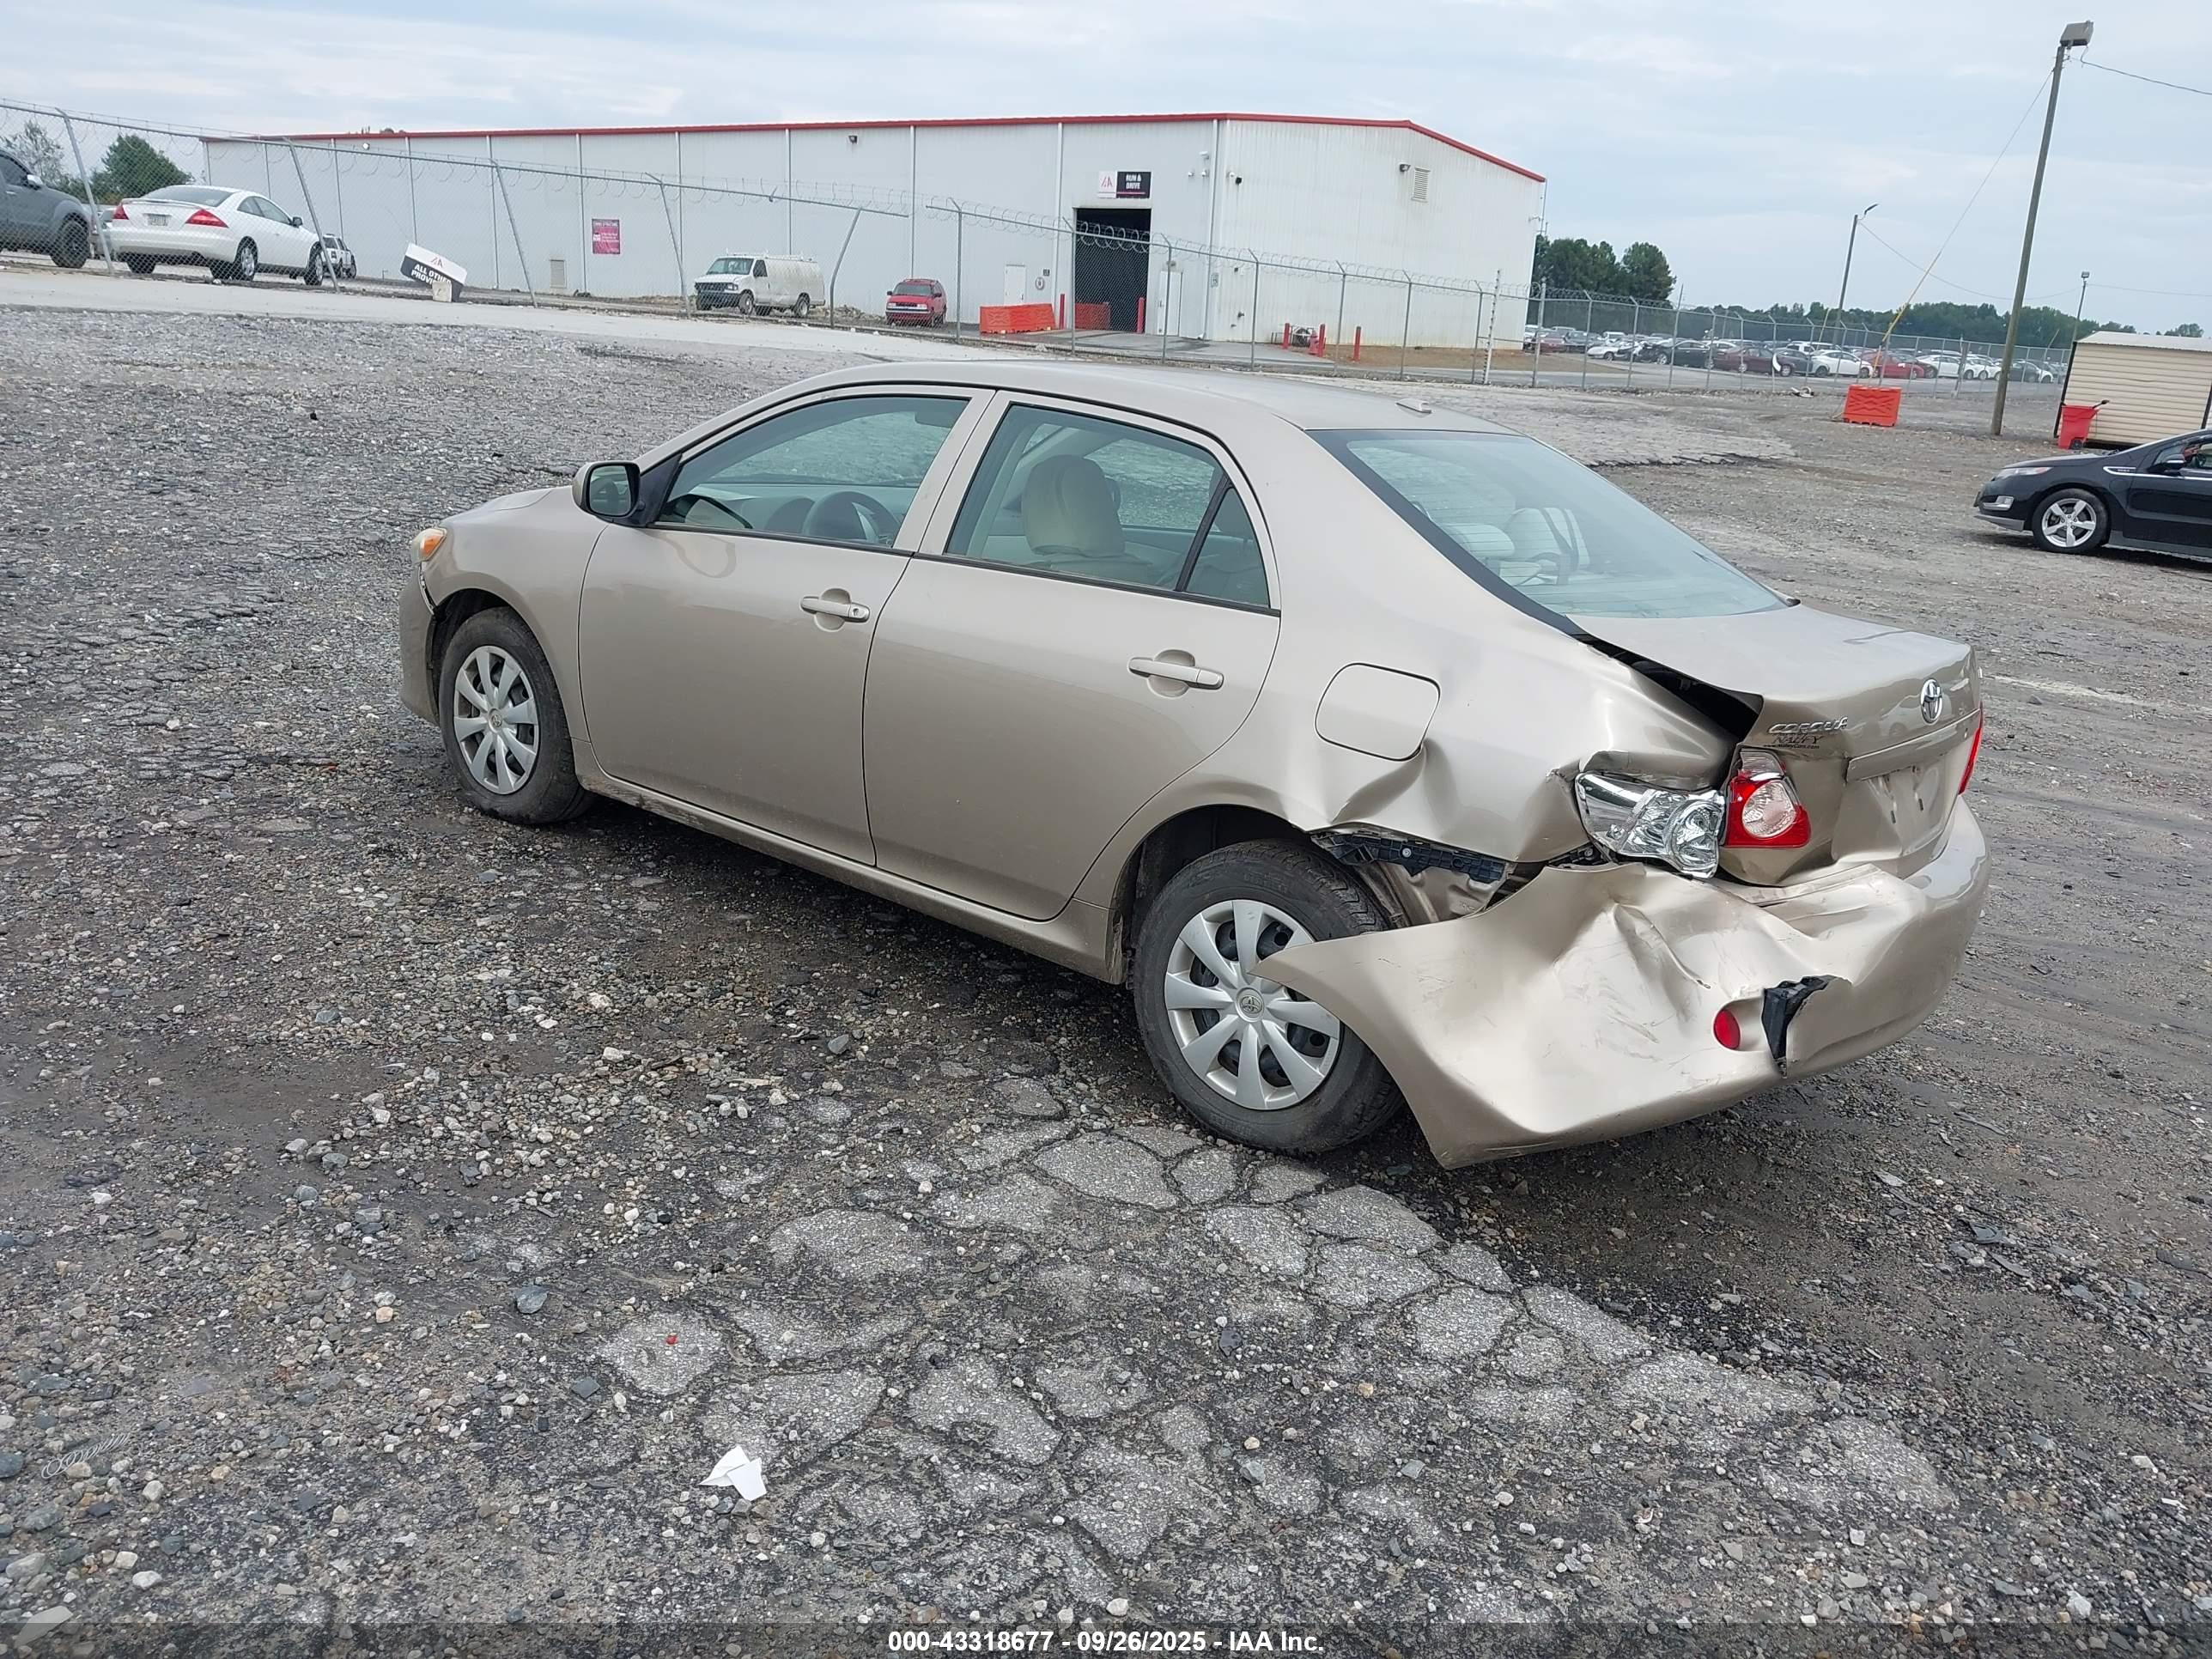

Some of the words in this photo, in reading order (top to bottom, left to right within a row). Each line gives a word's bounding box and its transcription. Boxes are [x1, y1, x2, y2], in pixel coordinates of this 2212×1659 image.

[1126, 173, 1136, 182] RUN
[414, 264, 428, 275] ALL
[410, 270, 433, 285] PROVI
[1767, 716, 1848, 734] COROLLA
